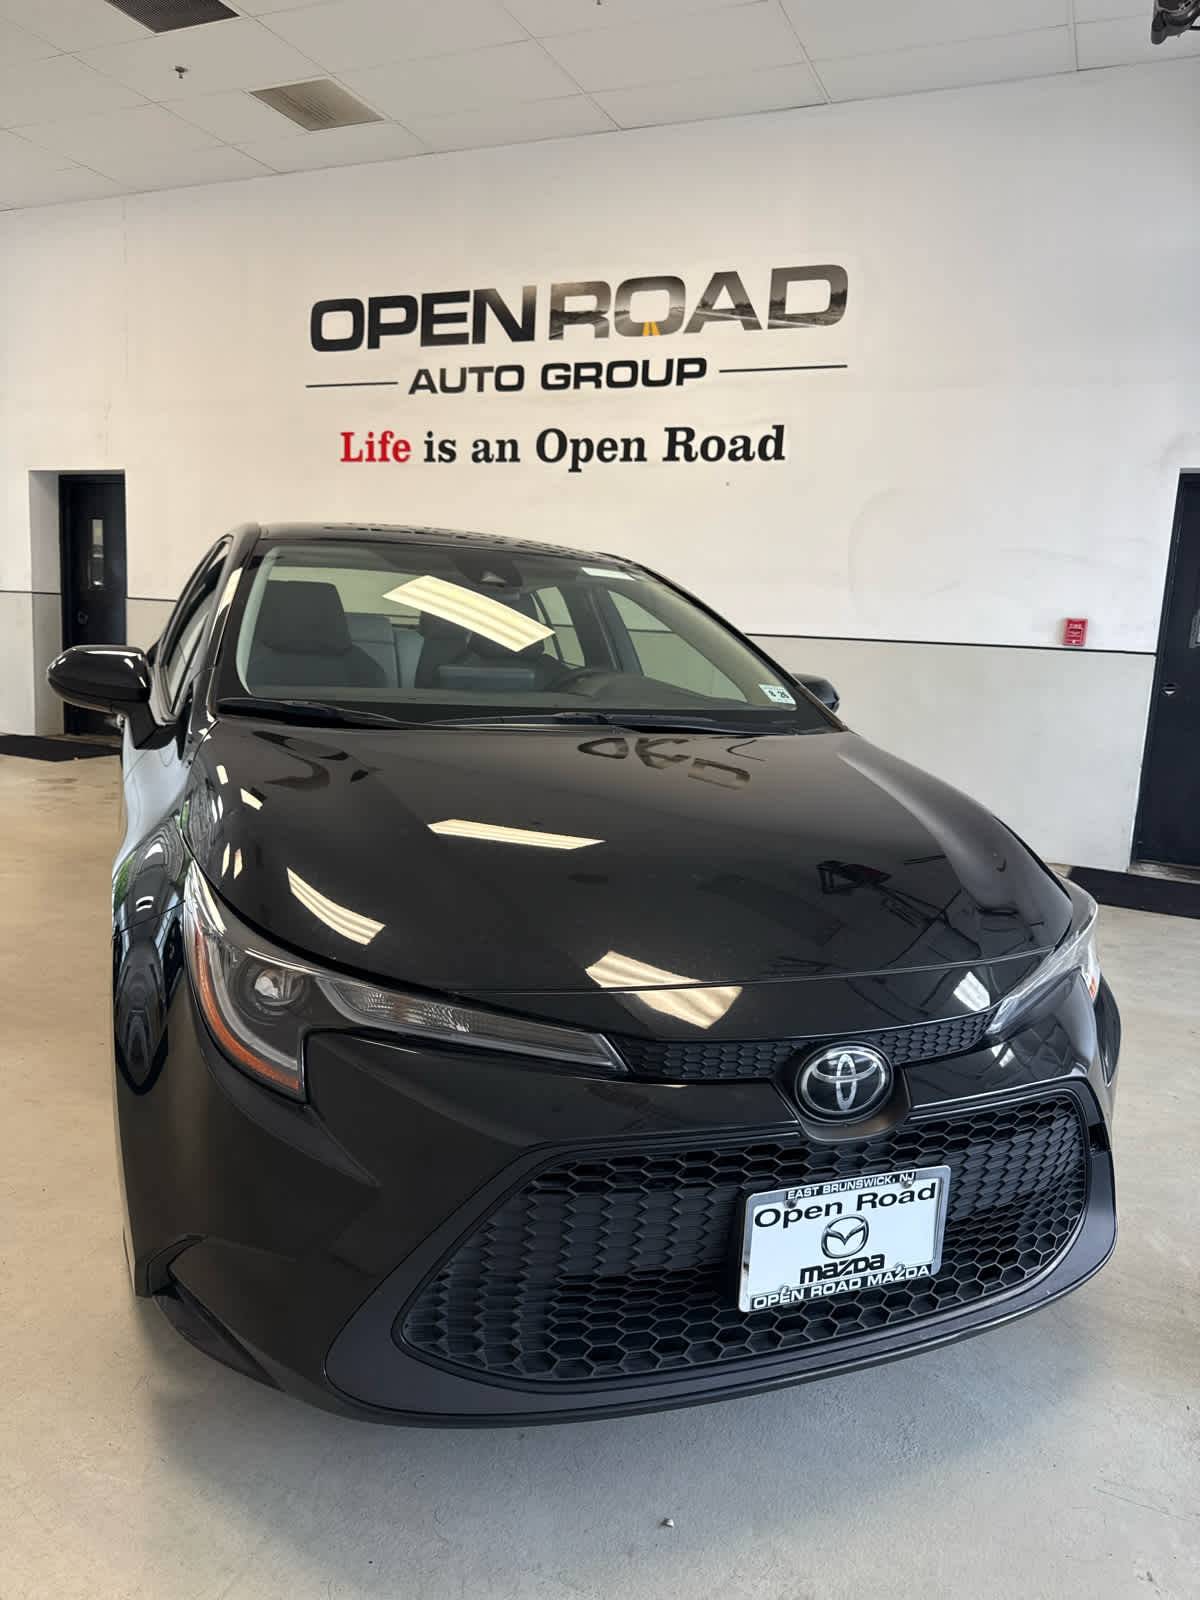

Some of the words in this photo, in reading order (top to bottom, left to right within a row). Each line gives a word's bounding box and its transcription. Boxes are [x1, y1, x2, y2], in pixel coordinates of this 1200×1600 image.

[310, 286, 537, 352] OPEN
[548, 264, 848, 341] ROAD
[408, 364, 525, 396] AUTO
[540, 357, 707, 390] GROUP
[340, 430, 412, 463] Life
[424, 430, 457, 463] is
[471, 438, 521, 463] an
[535, 427, 648, 473] Open
[662, 424, 786, 463] Road
[754, 1200, 843, 1229] Open
[856, 1182, 937, 1211] Road
[787, 1187, 819, 1201] EAST
[899, 1171, 916, 1182] NJ
[753, 1289, 805, 1309] OPEN
[811, 1277, 861, 1298] ROAD
[868, 1265, 930, 1286] MAZDA
